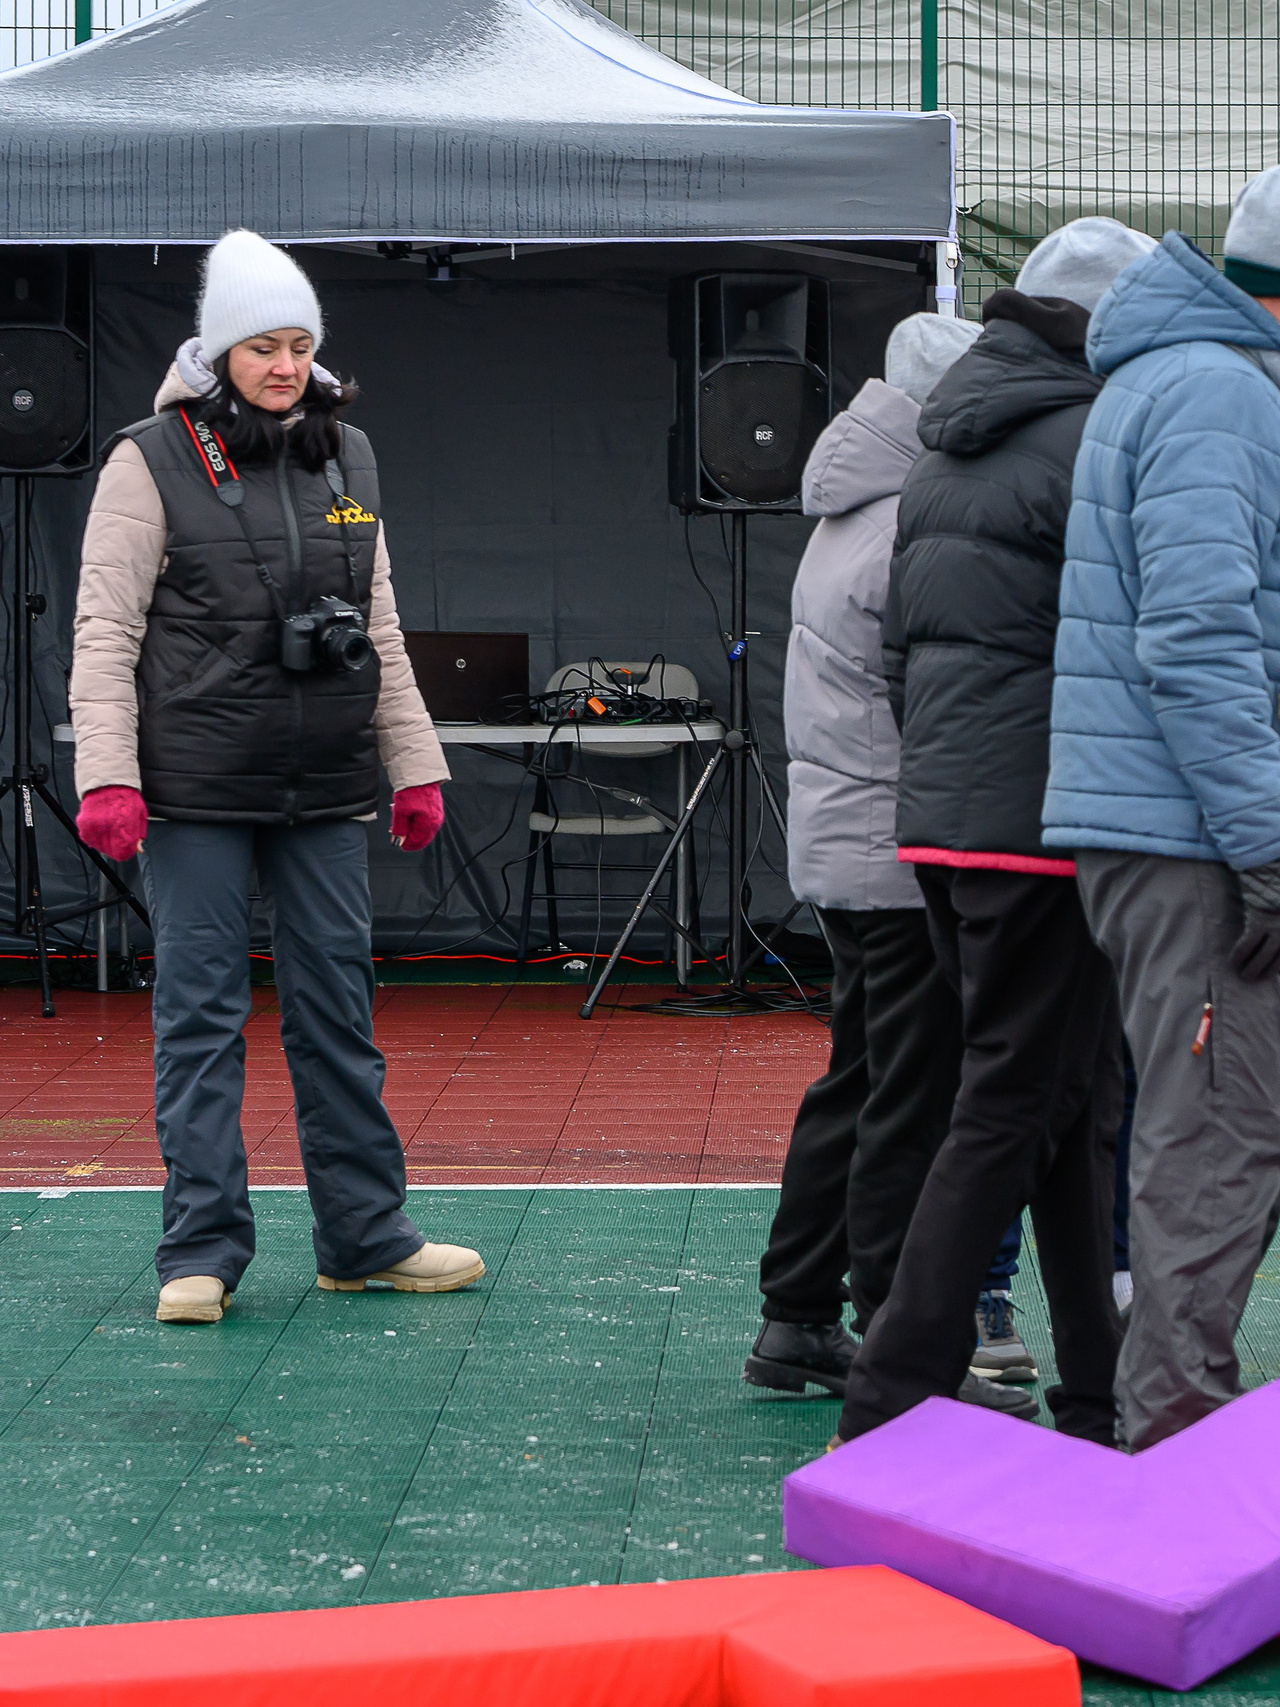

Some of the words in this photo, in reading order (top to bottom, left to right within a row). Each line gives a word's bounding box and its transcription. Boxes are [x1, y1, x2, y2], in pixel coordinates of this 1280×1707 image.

[15, 396, 32, 405] RCF
[755, 430, 773, 441] RCF
[203, 442, 226, 472] EOS
